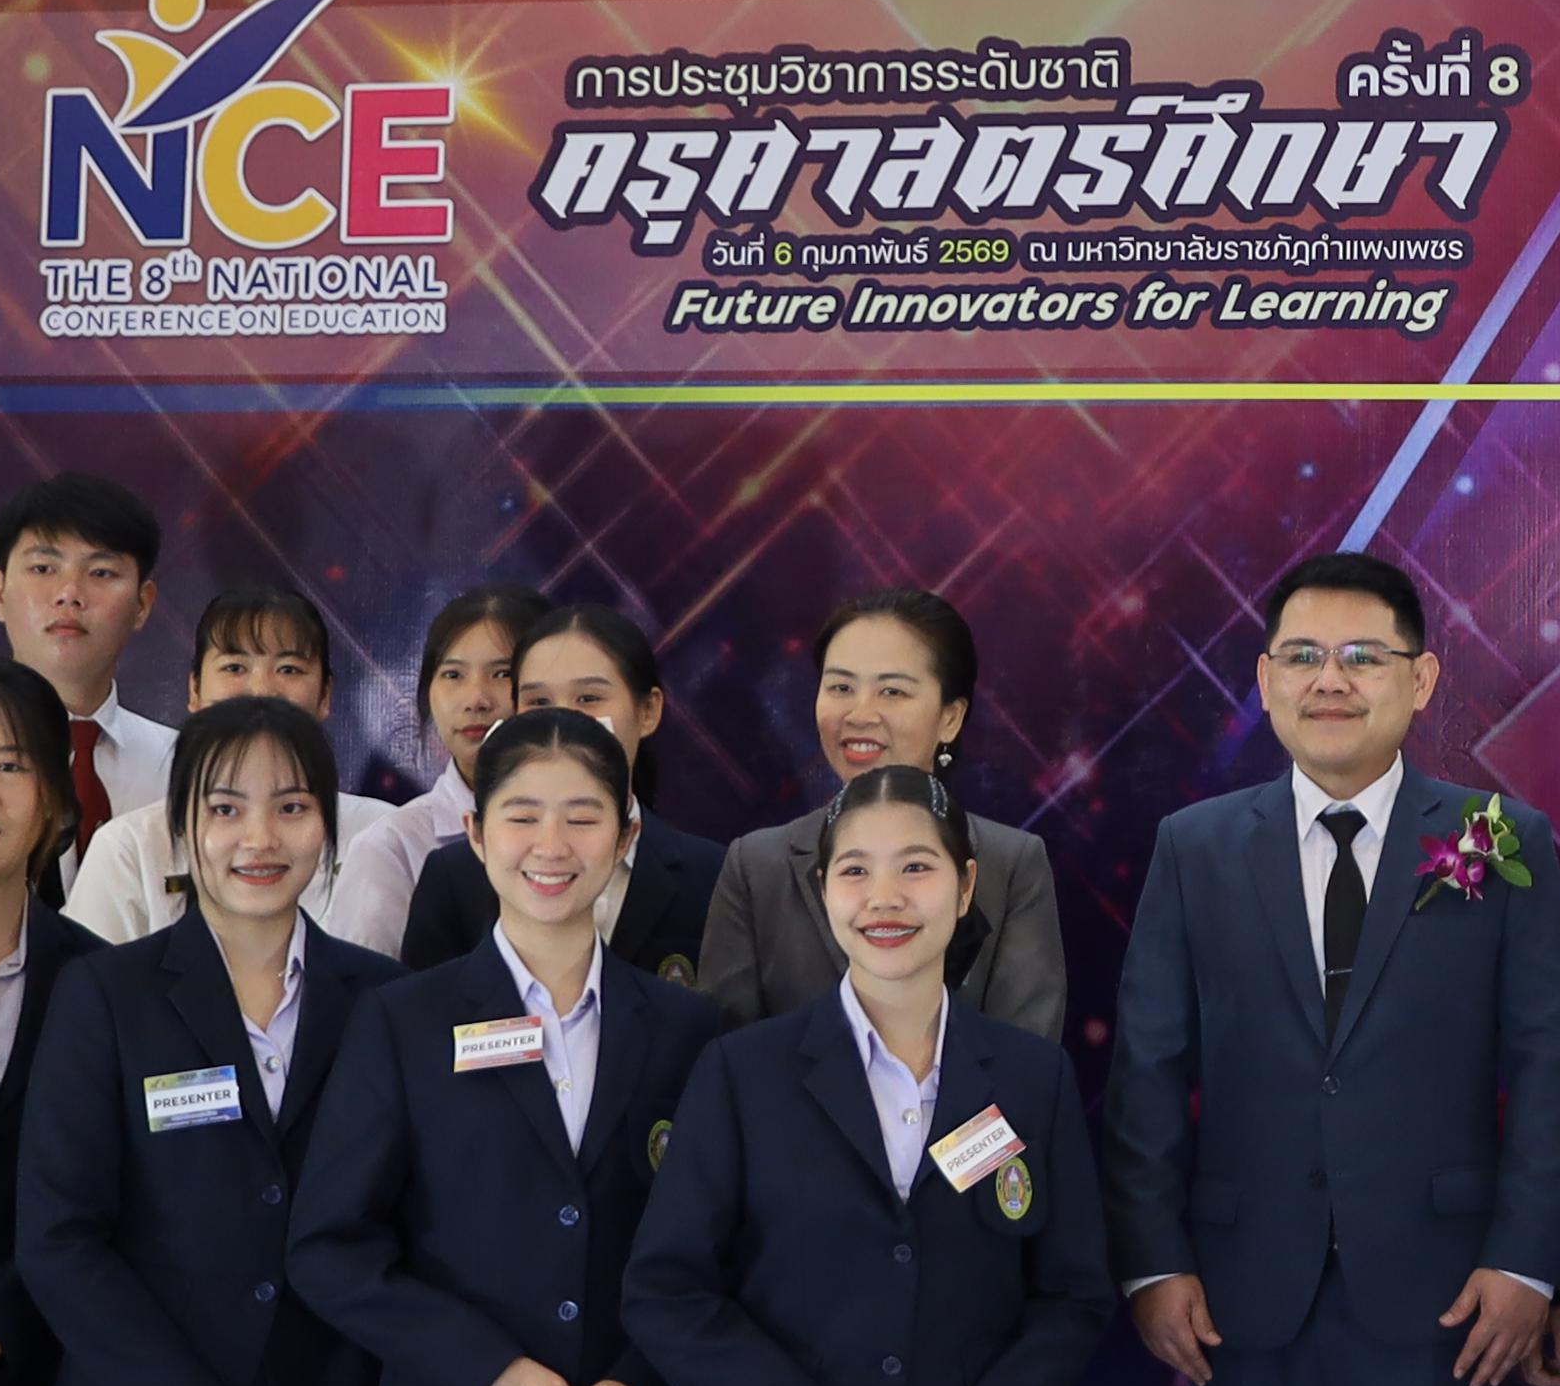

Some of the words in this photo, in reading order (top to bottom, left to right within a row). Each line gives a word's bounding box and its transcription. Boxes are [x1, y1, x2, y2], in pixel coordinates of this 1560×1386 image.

[575, 48, 1120, 106] การประชุมวิชาการระดับชาติ
[1348, 39, 1471, 97] ครั้งที่
[1487, 56, 1520, 97] 8
[540, 93, 1499, 245] ครุศาสตร์ศึกษา
[711, 233, 765, 266] วันที่
[773, 241, 792, 265] 6
[801, 236, 928, 270] กุมภาพันธ์
[938, 239, 1009, 264] 2569
[1029, 239, 1057, 262] ณ
[1067, 233, 1464, 266] มหาวิทยาลัยราชภัฏกำแพงเพชร
[46, 264, 128, 296] THE
[145, 254, 199, 296] 8th
[213, 260, 442, 294] NATIONAL
[46, 310, 231, 332] CONFERENCE
[240, 309, 277, 330] ON
[288, 308, 442, 330] EDUCATION
[671, 288, 837, 326] Future
[849, 284, 1118, 325] Innovators
[1134, 280, 1211, 322] for
[1219, 278, 1449, 332] Learning
[462, 1035, 536, 1054] PRESENTER
[153, 1088, 231, 1110] PRESENTER
[946, 1126, 1007, 1172] PRESENTER
